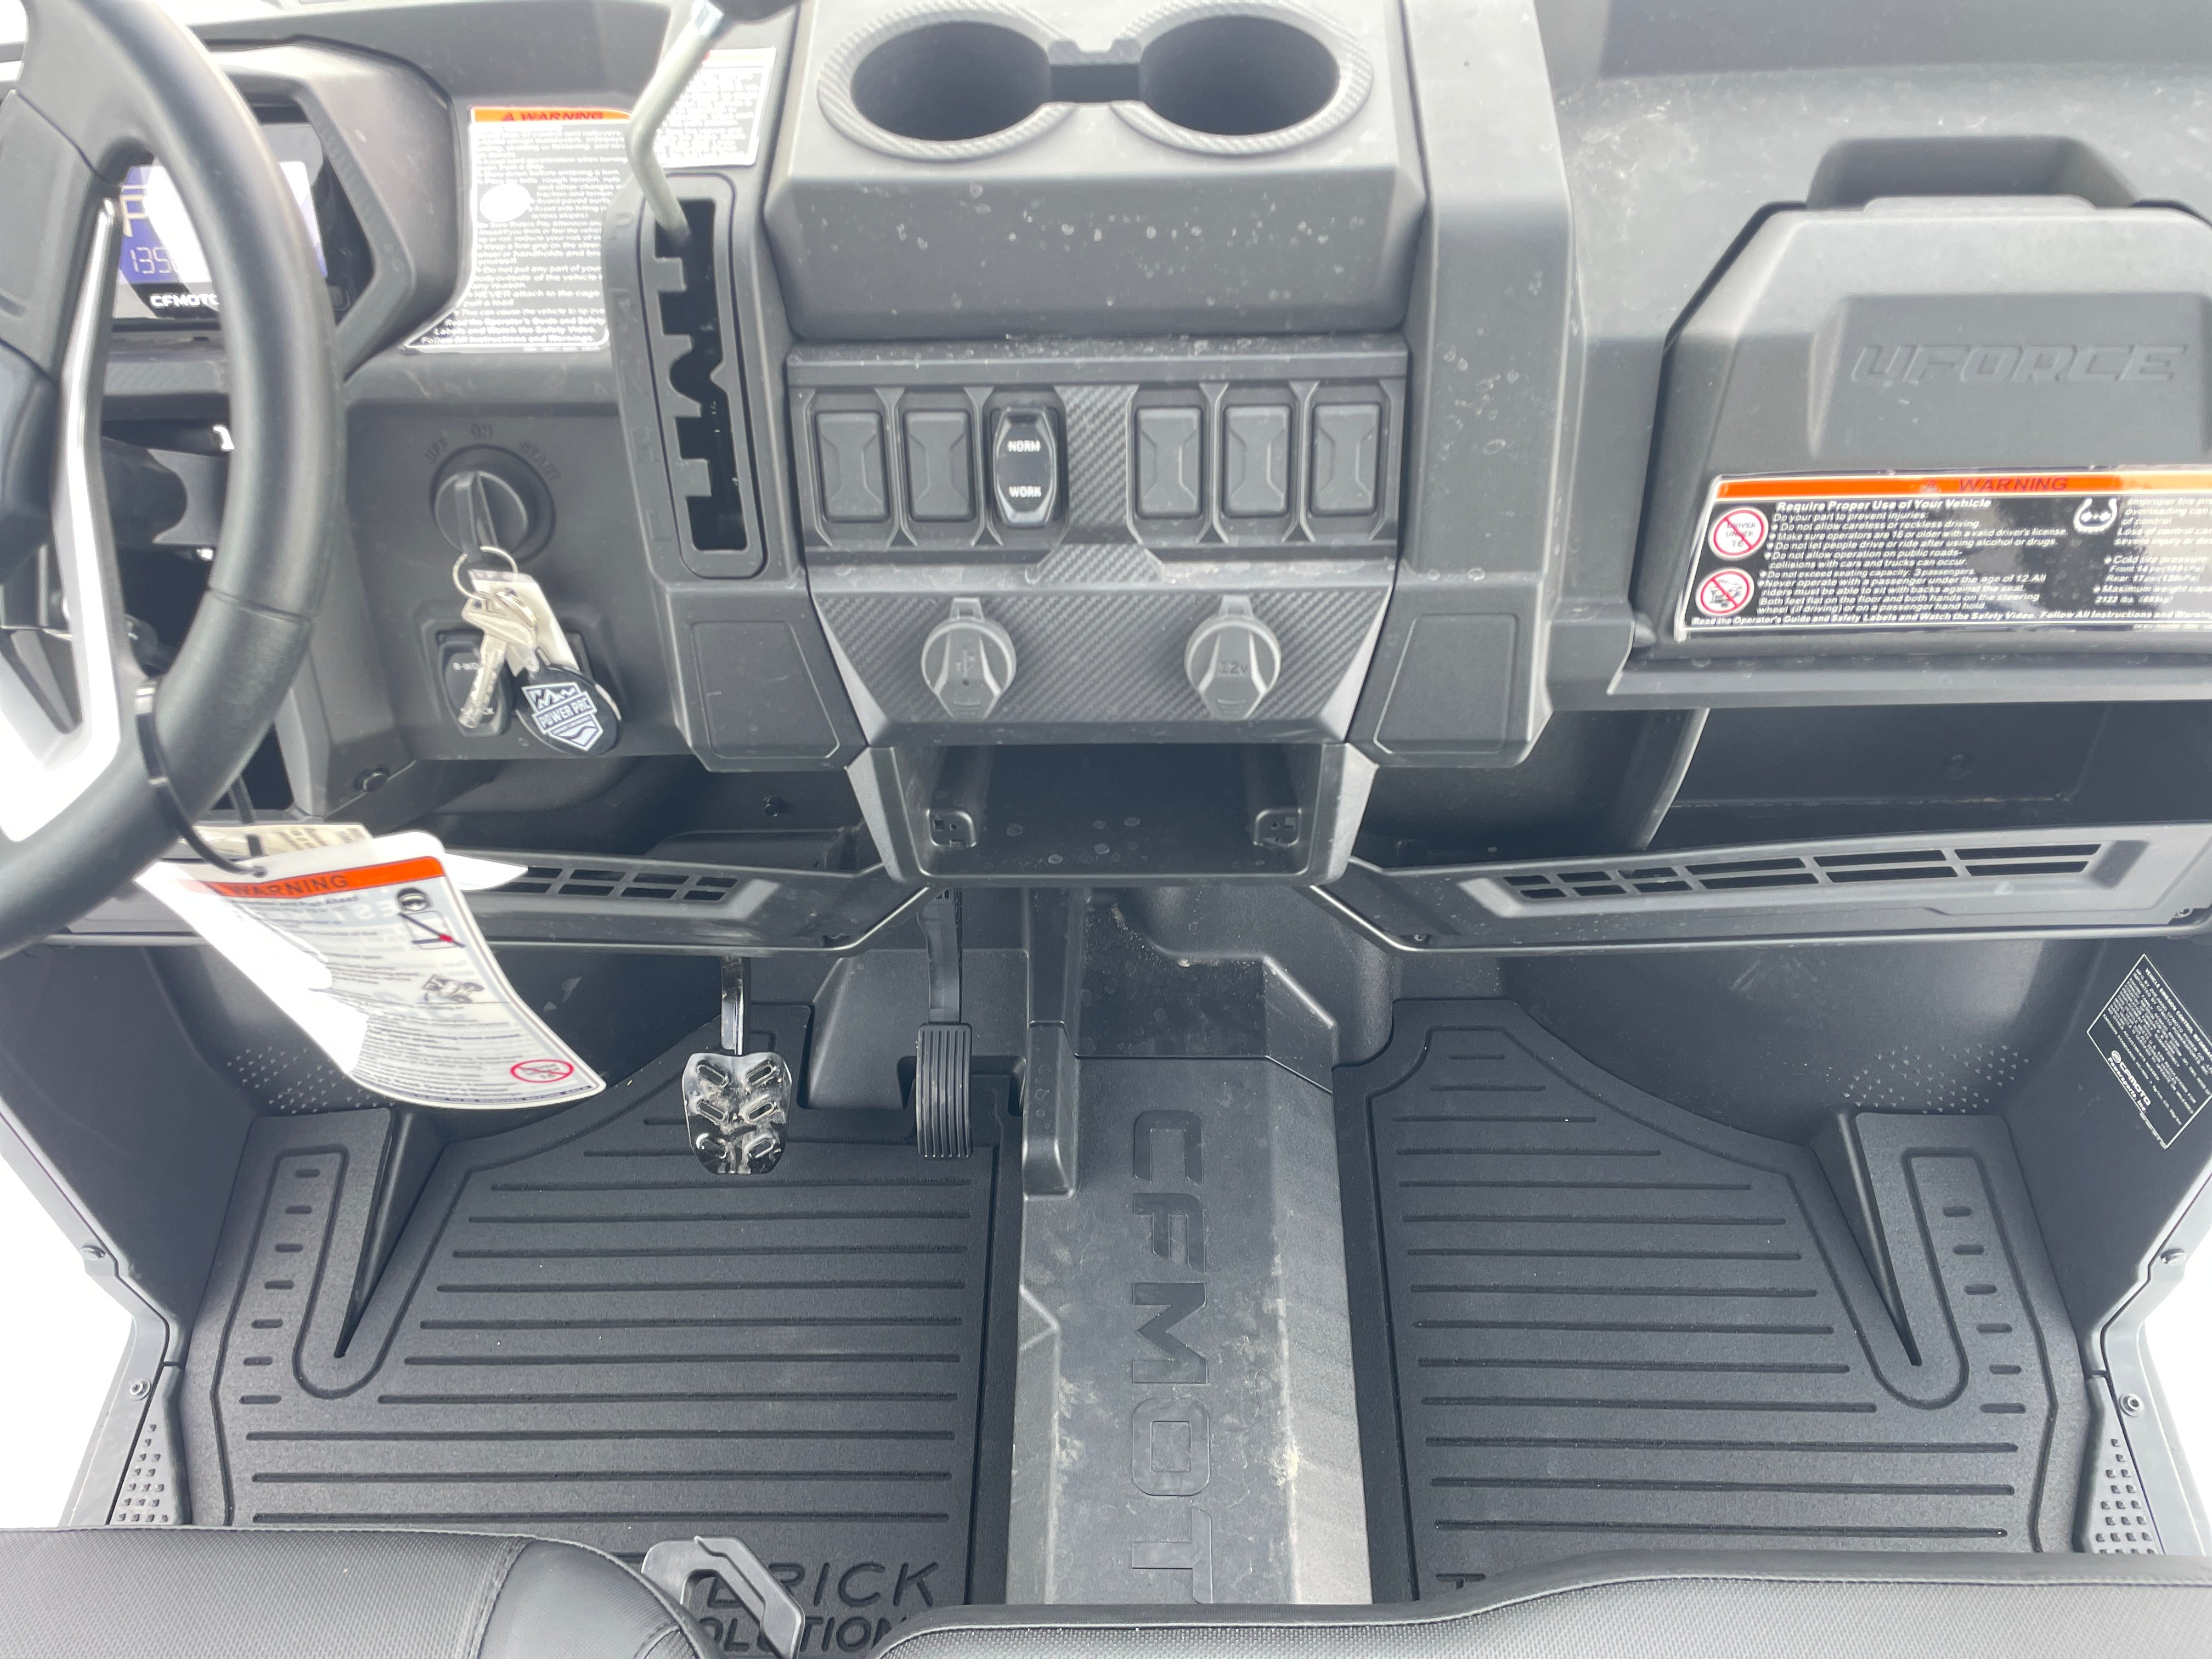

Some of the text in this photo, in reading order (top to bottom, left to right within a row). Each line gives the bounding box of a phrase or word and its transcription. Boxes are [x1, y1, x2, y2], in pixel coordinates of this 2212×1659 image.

[521, 111, 602, 121] WARNING
[1007, 439, 1041, 452] NORM
[1959, 477, 2068, 492] WARNING
[1008, 486, 1042, 498] WORK
[1777, 498, 1991, 512] Require Proper Use of Your Vehicle
[1789, 514, 1812, 523] your
[1813, 513, 1834, 522] part
[1847, 512, 1887, 522] prevent
[1815, 522, 1842, 530] allow
[1843, 521, 1886, 529] careless
[1900, 520, 1943, 529] reckless
[1826, 532, 1872, 540] operators
[1892, 530, 1903, 538] 16
[1917, 529, 1942, 538] older
[1943, 529, 1962, 538] with
[1972, 528, 1995, 537] valid
[1775, 541, 1789, 550] Do
[1824, 541, 1858, 550] people
[1859, 540, 1885, 549] drive
[1920, 539, 1945, 548] after
[1945, 539, 1974, 549] using
[1976, 538, 2013, 546] alcohol
[1772, 551, 1786, 560] Do
[1806, 551, 1833, 559] allow
[1833, 550, 1882, 559] operation
[1897, 549, 1928, 558] public
[1769, 561, 1816, 569] collisions
[1818, 560, 1838, 568] with
[1884, 558, 1915, 567] trucks
[1768, 570, 1781, 578] Do
[1798, 569, 1832, 578] exceed
[1833, 569, 1867, 578] seating
[1765, 579, 1796, 587] Never
[1797, 579, 1837, 587] operate
[1838, 578, 1861, 586] with
[1870, 578, 1927, 586] passenger
[1981, 576, 2001, 584] age
[2002, 574, 2015, 582] of
[1759, 597, 1784, 605] Both
[1996, 593, 2040, 602] steering
[1757, 605, 1788, 613] wheel
[1879, 603, 1934, 612] passenger
[1934, 602, 1961, 610] hand
[1692, 616, 1716, 625] Read
[1831, 614, 1861, 623] Safety
[1863, 613, 1897, 622] Labels
[1920, 613, 1951, 621] Watch
[1970, 612, 2004, 621] Safety
[2040, 610, 2075, 618] Follow
[2074, 610, 2089, 618] All
[2090, 610, 2153, 618] Instructions
[538, 704, 574, 729] POWER
[2145, 967, 2160, 989] VEHICLE
[2175, 1009, 2194, 1035] CONTROL
[2118, 1060, 2151, 1107] CFMOTO
